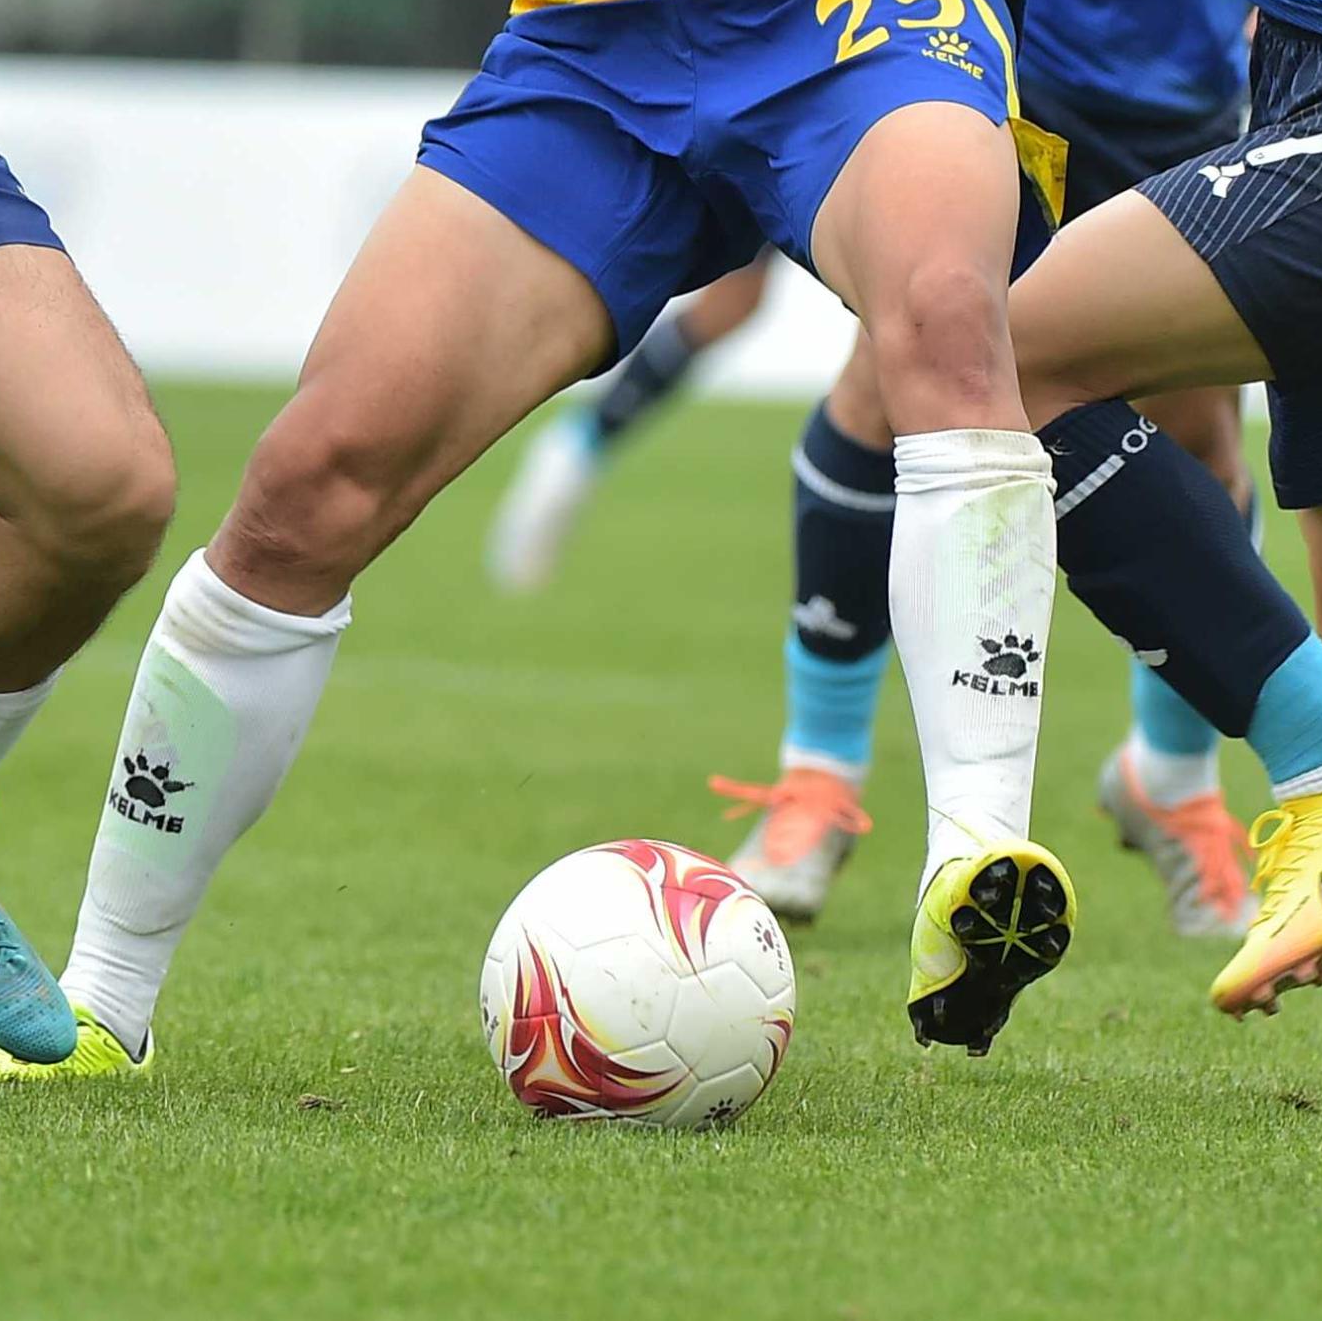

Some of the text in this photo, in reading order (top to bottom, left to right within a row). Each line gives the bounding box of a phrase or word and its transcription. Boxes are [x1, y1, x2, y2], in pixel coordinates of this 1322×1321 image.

[921, 48, 984, 81] KELME
[952, 669, 1039, 697] KELME
[109, 787, 184, 834] KELME
